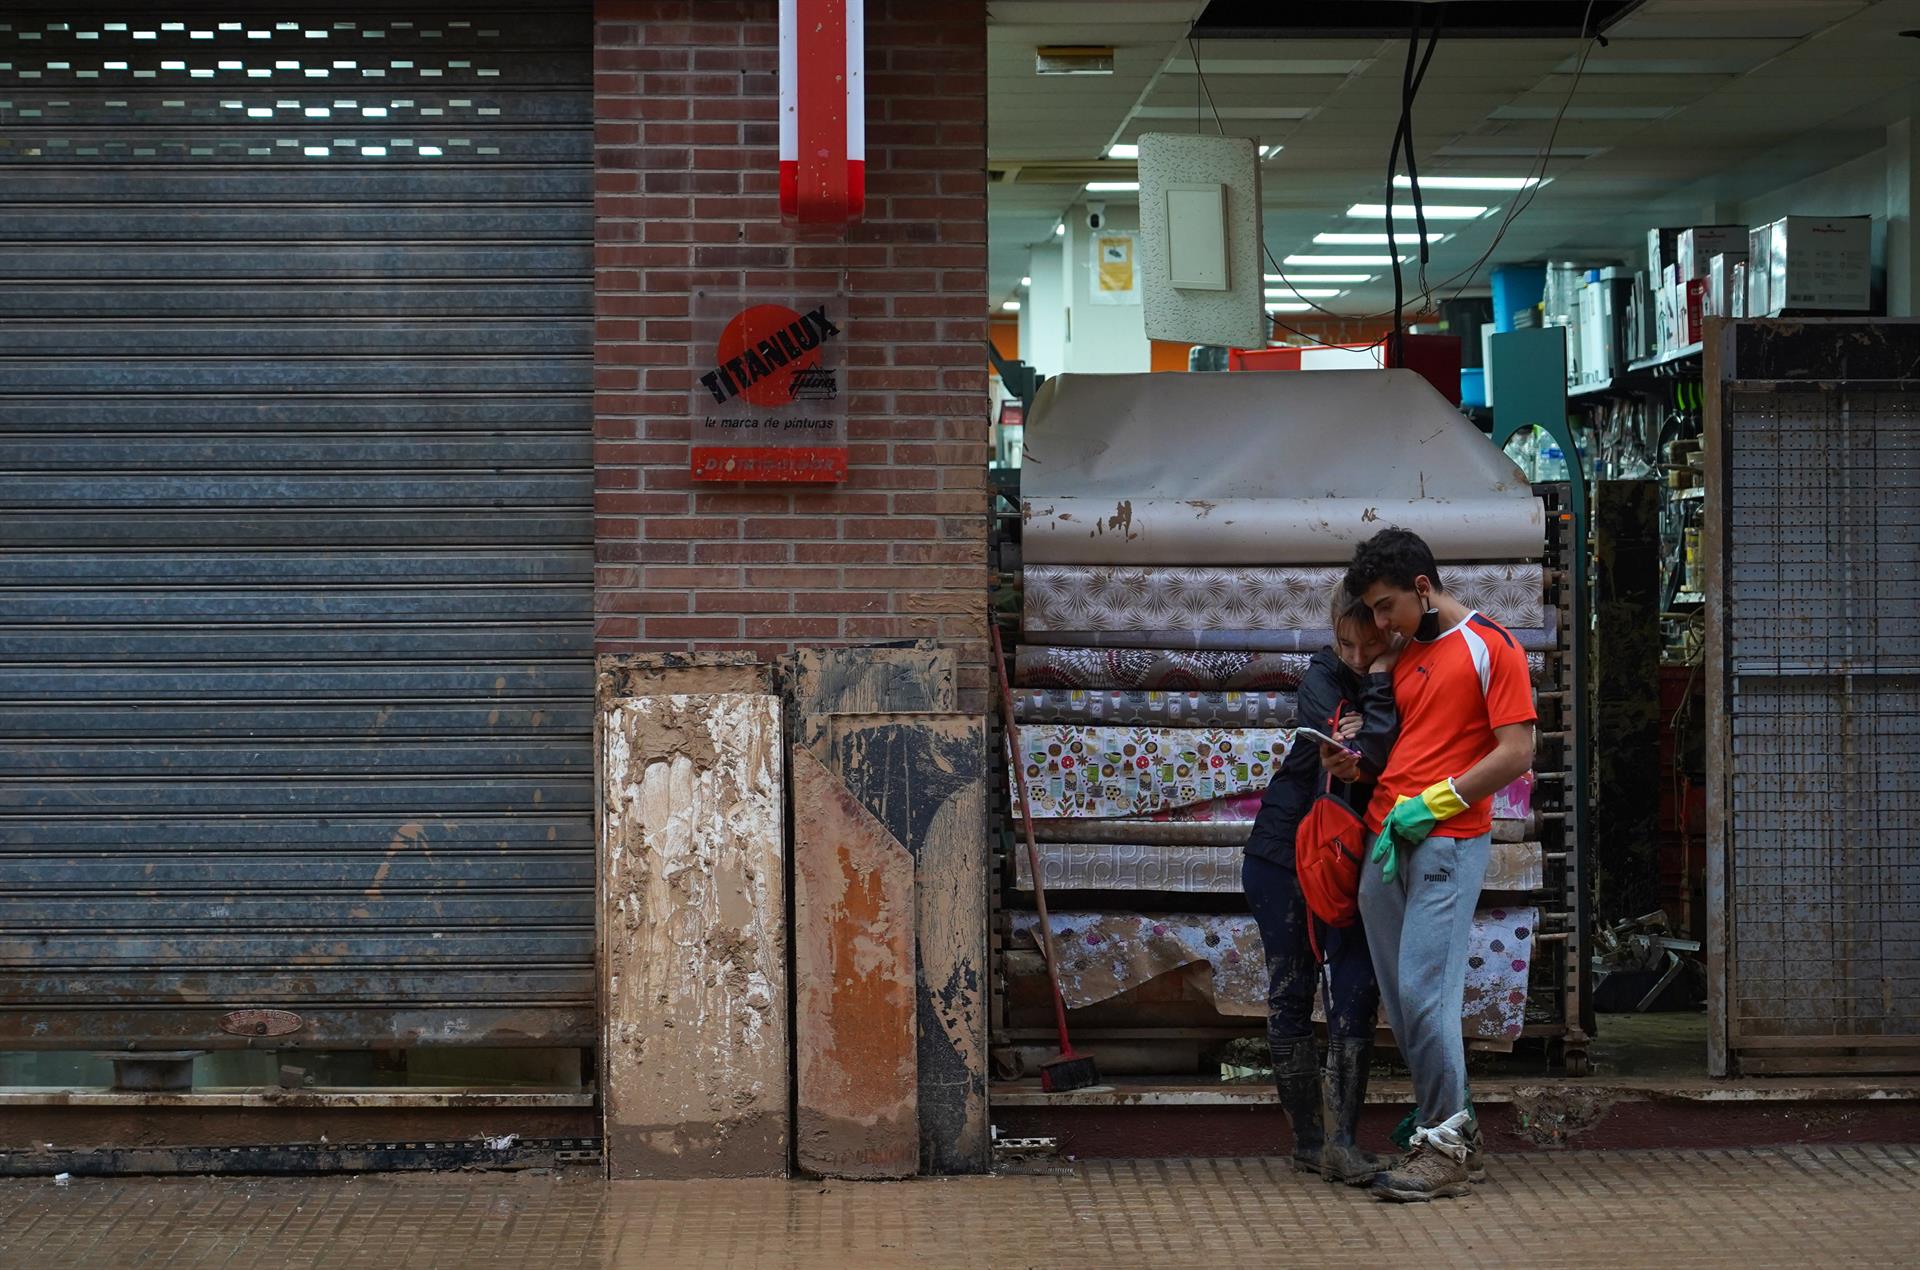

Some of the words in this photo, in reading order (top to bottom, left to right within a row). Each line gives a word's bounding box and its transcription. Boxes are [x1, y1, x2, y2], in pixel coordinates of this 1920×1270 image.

[700, 305, 841, 405] TITANLUX
[704, 416, 717, 428] la
[720, 418, 759, 428] marca
[764, 417, 780, 428] de
[783, 416, 834, 431] pinturas
[1424, 873, 1447, 882] PUMA
